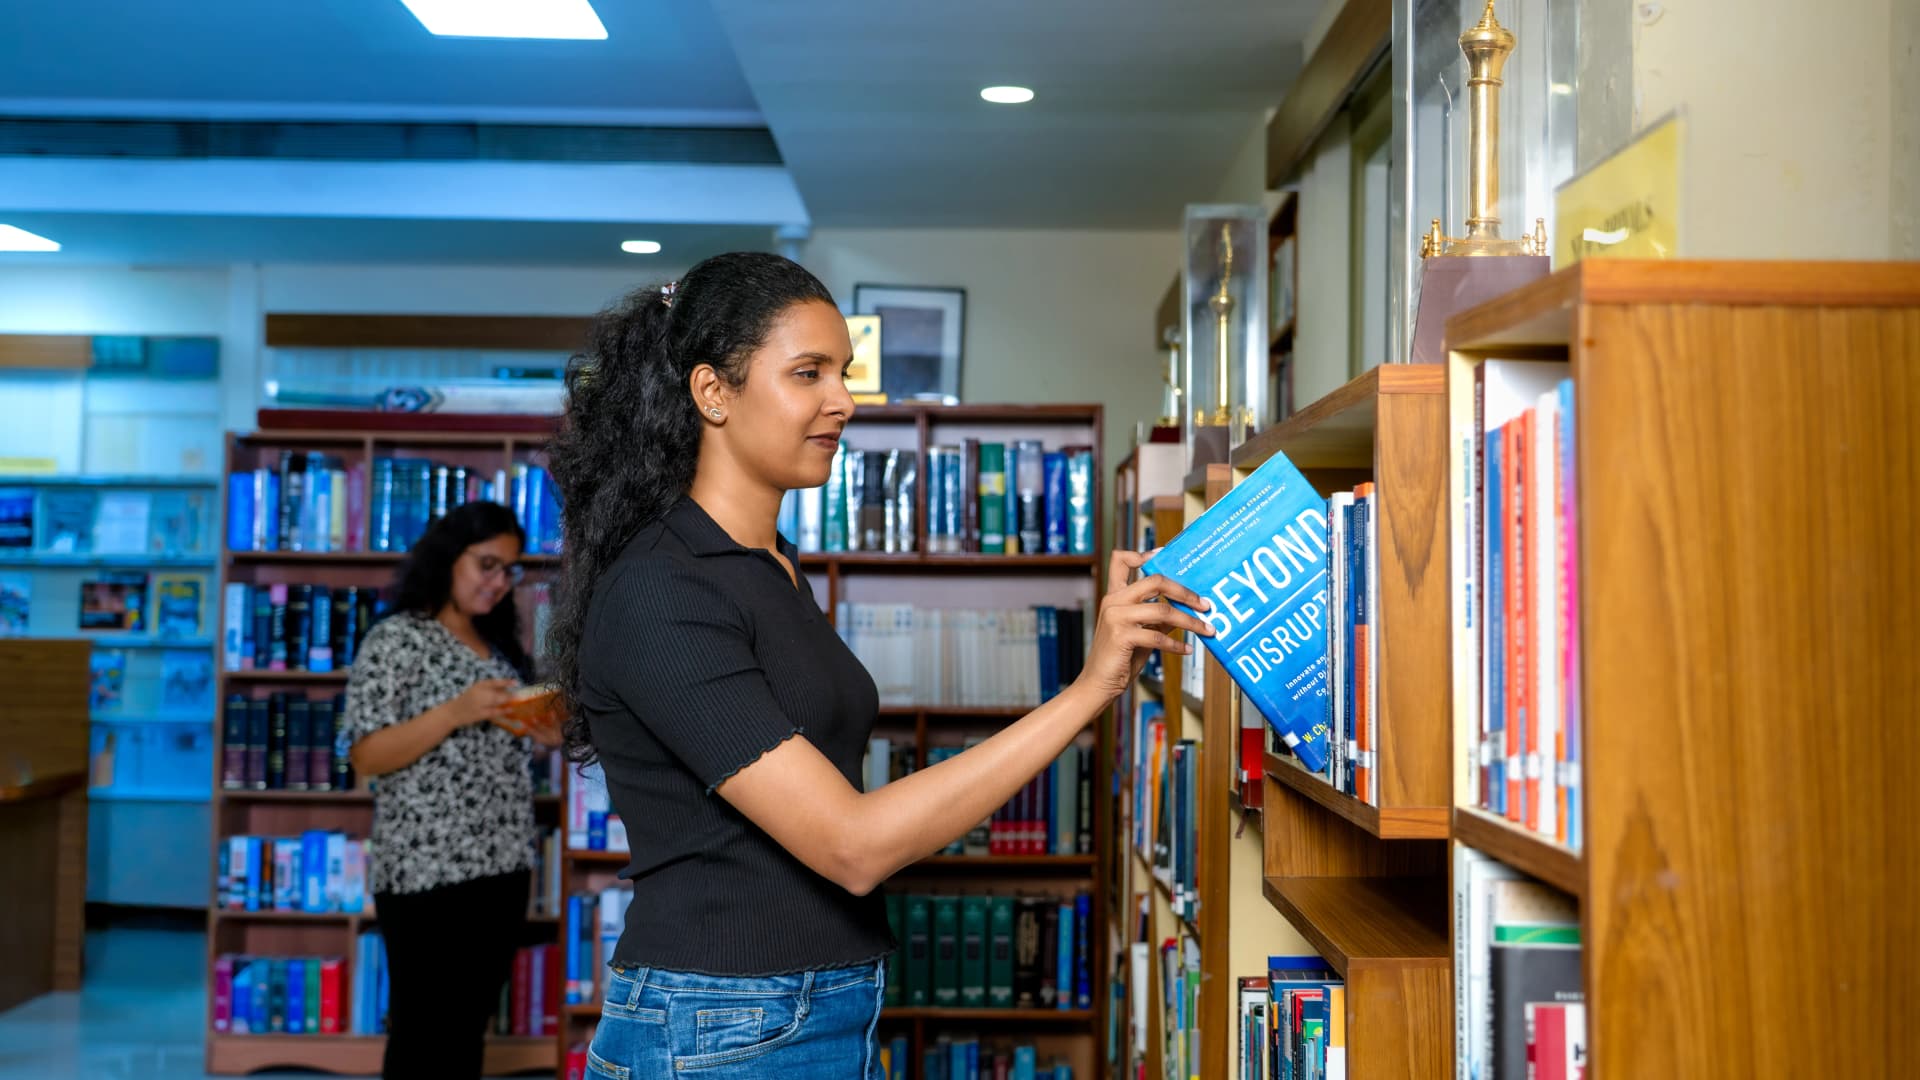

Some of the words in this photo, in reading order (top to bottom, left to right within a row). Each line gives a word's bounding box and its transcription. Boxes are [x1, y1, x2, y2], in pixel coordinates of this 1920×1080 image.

[1178, 552, 1190, 563] From
[1216, 520, 1229, 532] BLUE
[1229, 506, 1246, 521] OCEAN
[1198, 536, 1224, 559] bestselling
[1222, 520, 1243, 539] business
[1241, 509, 1256, 522] books
[1194, 508, 1327, 641] BEYOND
[1285, 663, 1317, 690] Innovate
[1316, 653, 1327, 666] an
[1291, 676, 1319, 701] without
[1302, 731, 1317, 744] W.
[1312, 720, 1327, 736] Ch
